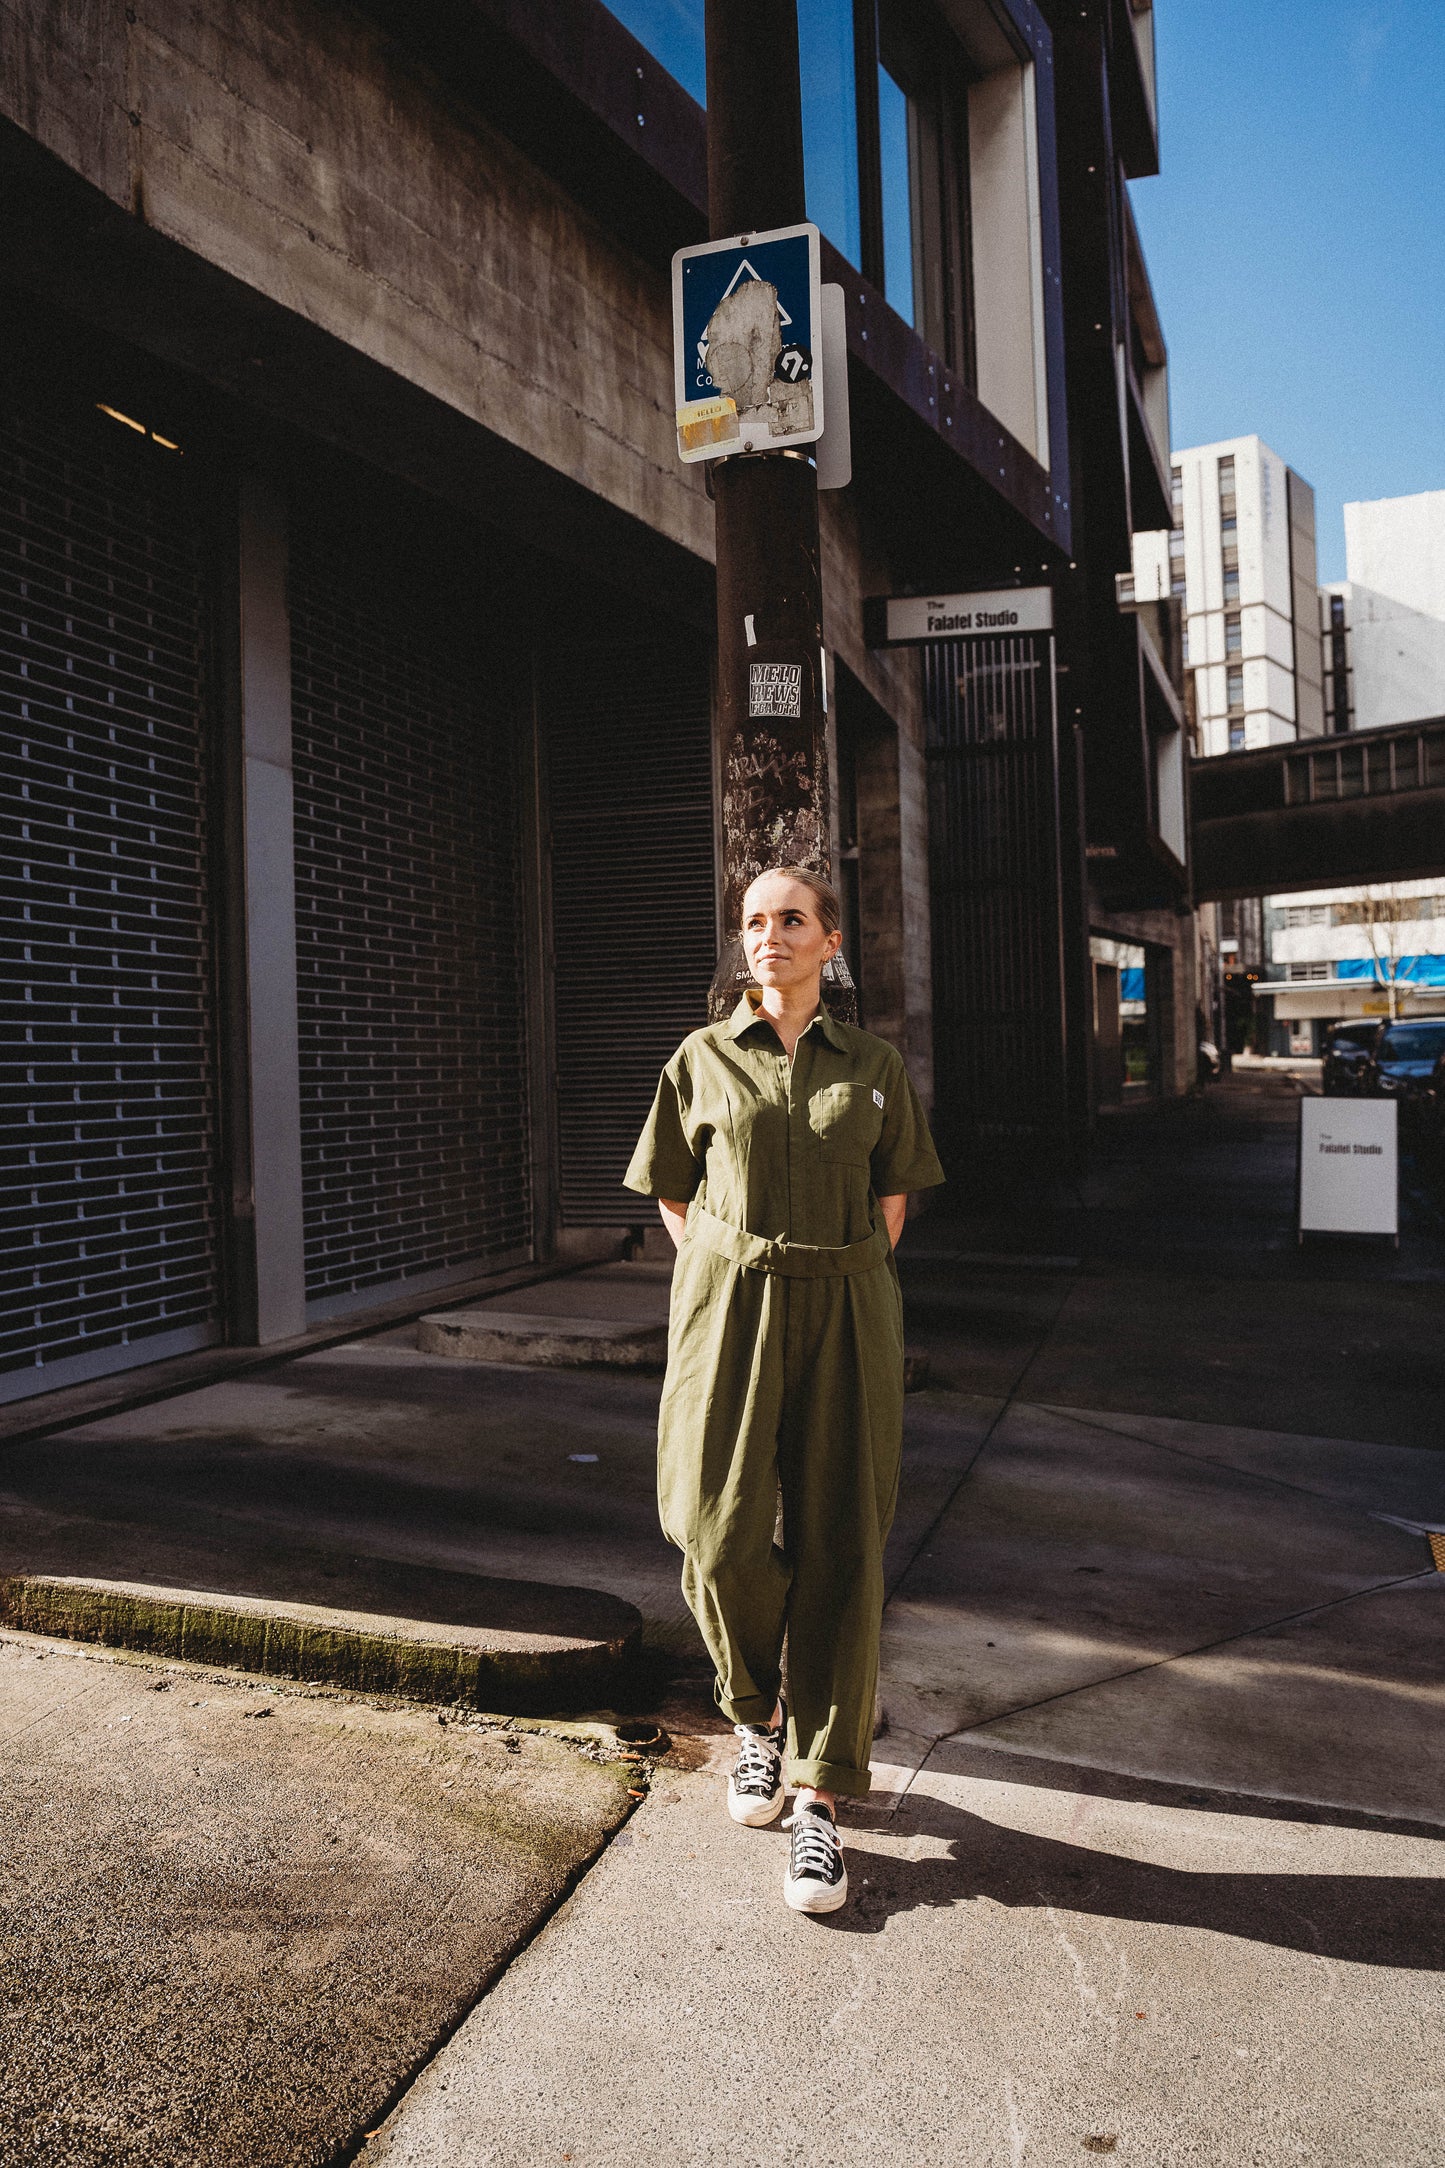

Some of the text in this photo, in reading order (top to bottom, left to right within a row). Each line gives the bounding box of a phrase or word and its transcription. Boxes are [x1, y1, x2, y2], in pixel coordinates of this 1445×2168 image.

[927, 601, 945, 610] The
[927, 609, 1018, 631] Falafel Studio
[735, 970, 754, 980] SM
